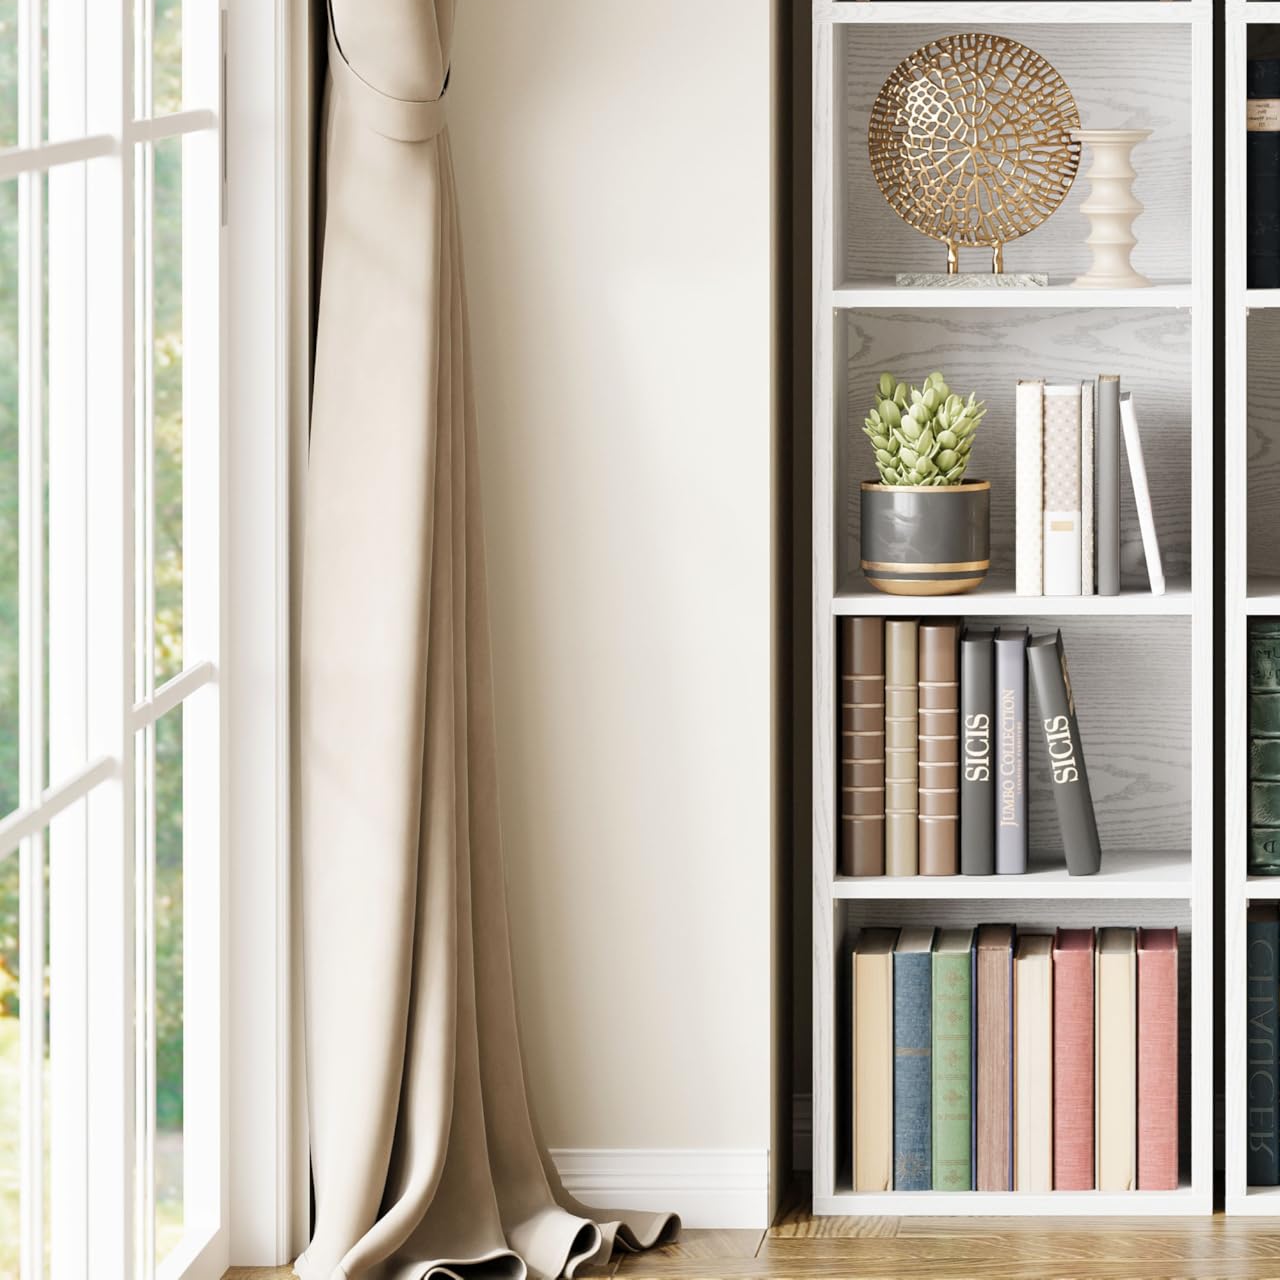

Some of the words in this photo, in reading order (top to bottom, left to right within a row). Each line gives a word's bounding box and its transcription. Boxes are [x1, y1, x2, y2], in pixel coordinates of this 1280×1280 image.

[964, 712, 990, 782] SICIS
[999, 688, 1016, 776] COLLECTION
[1044, 714, 1079, 784] SICIS
[999, 780, 1020, 828] JUMBO
